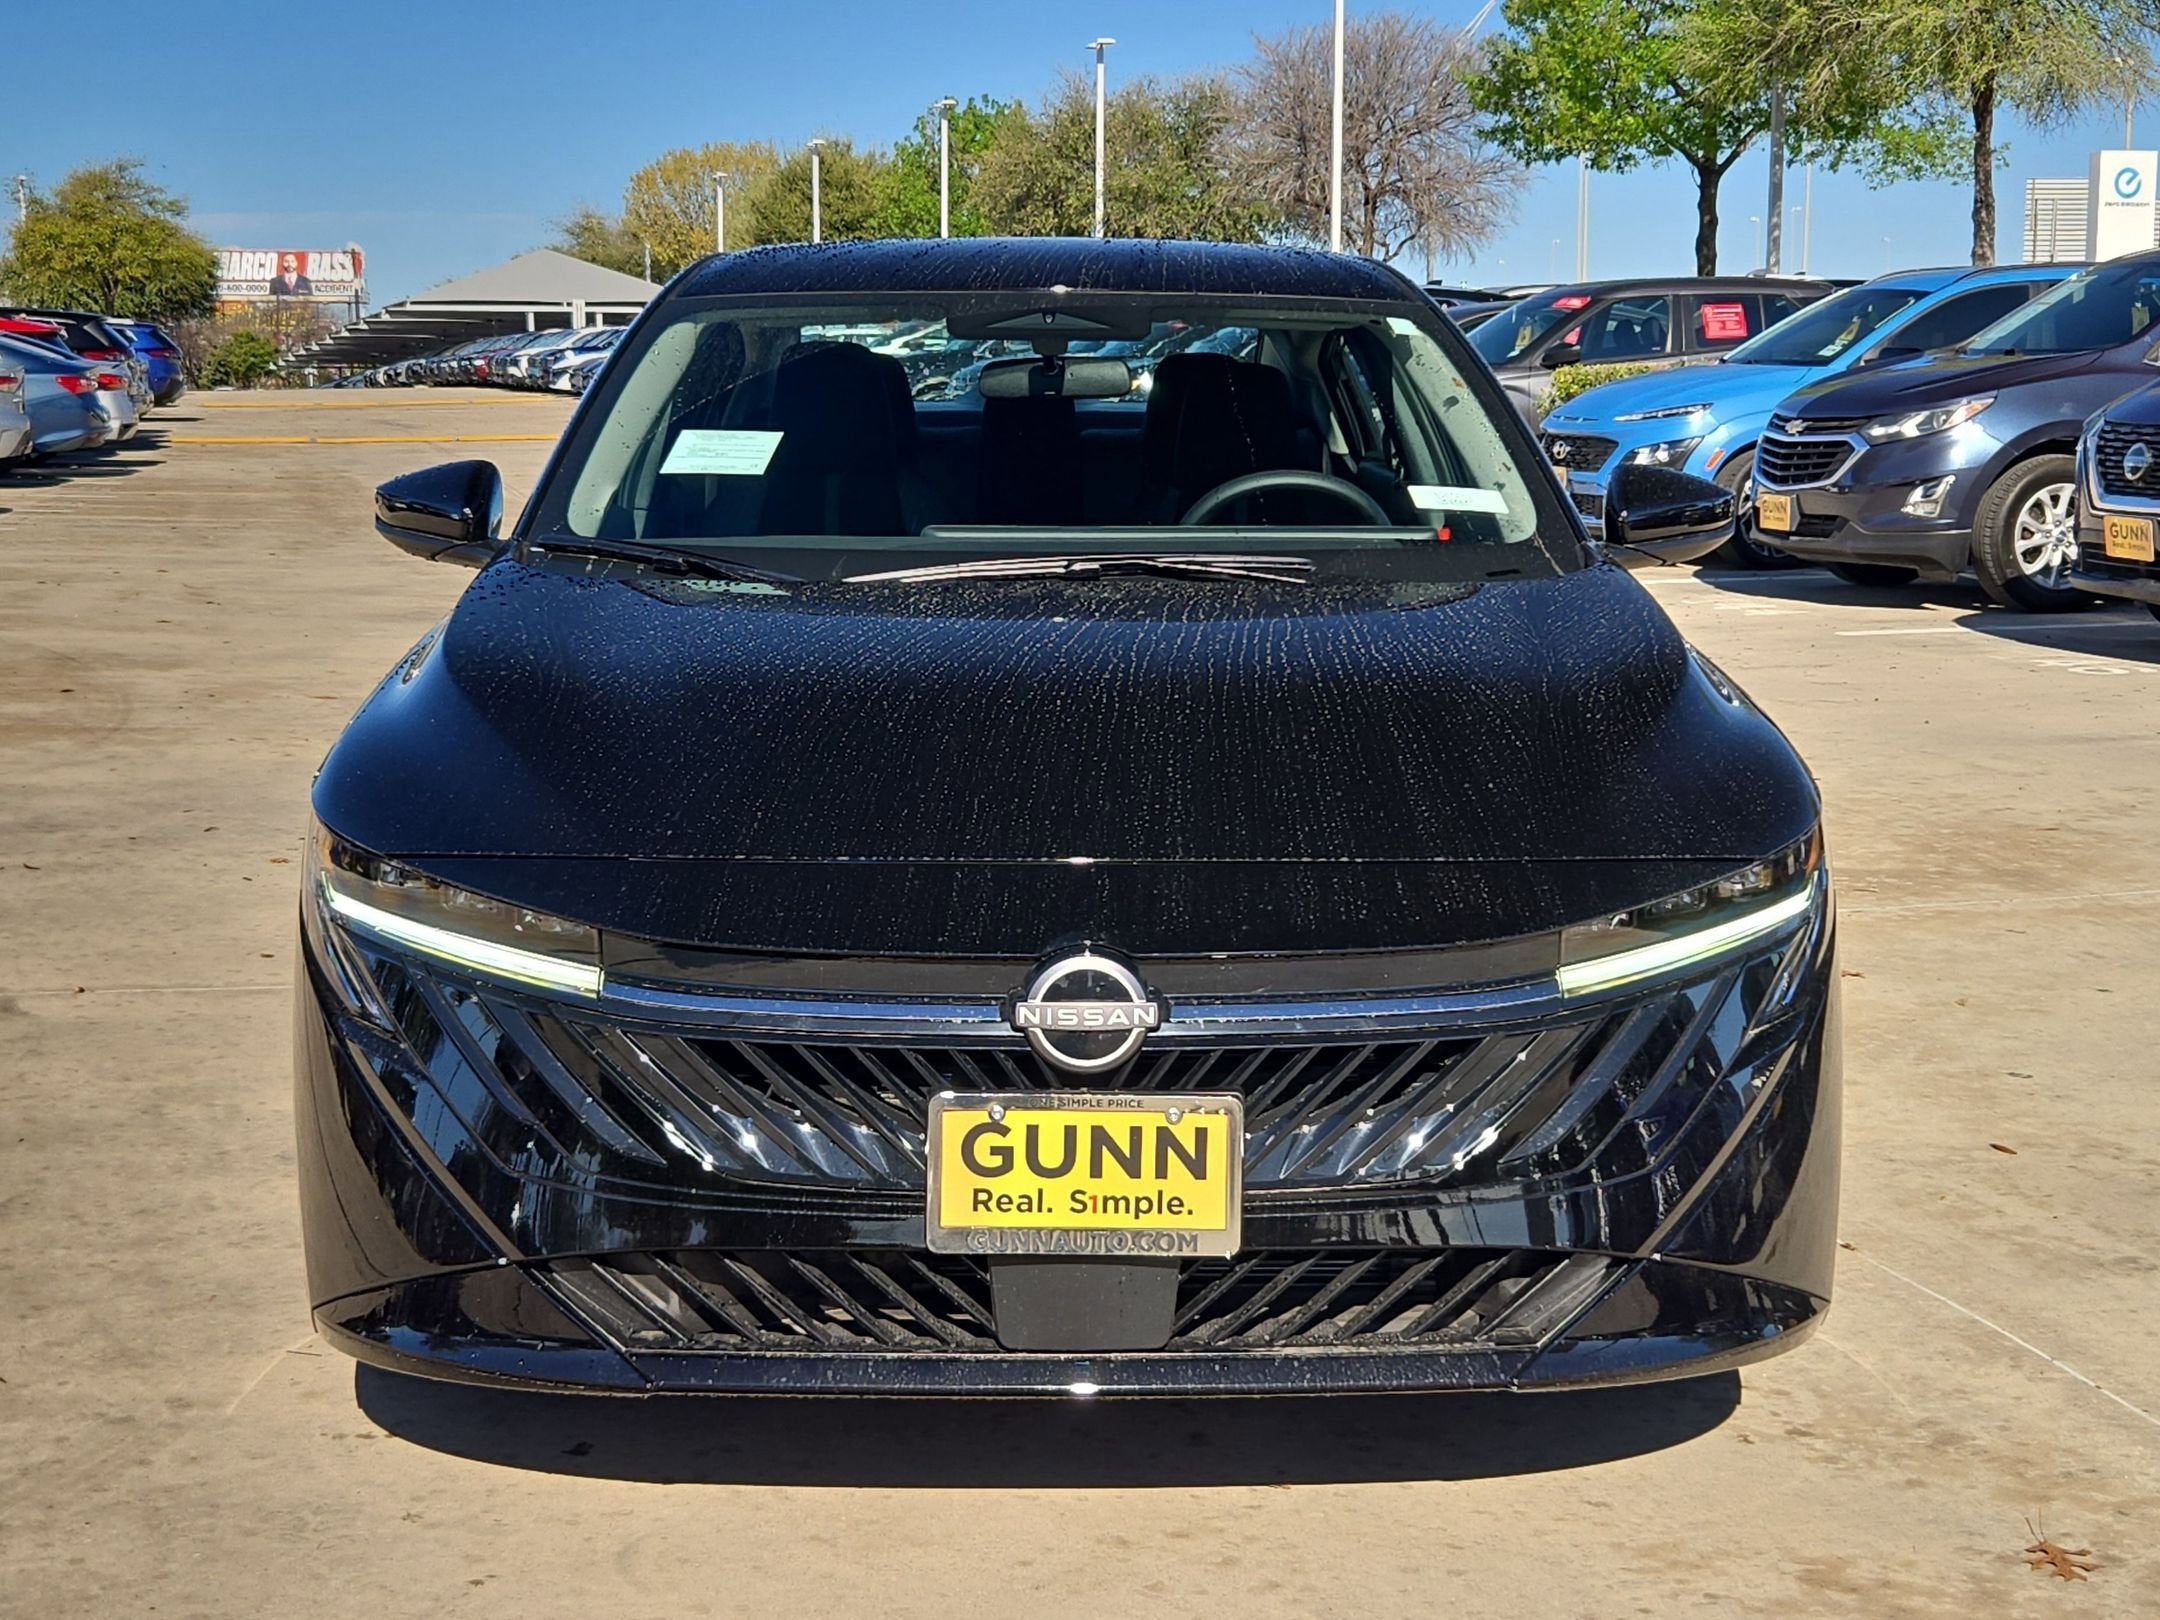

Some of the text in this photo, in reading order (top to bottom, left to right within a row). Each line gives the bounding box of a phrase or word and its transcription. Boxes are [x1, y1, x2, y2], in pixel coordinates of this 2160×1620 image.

[2110, 522, 2148, 542] GUNN
[1019, 1006, 1155, 1026] NISSAN
[1059, 1097, 1104, 1108] SIMPLE
[1108, 1098, 1145, 1109] PRICE
[961, 1122, 1208, 1180] GUNN
[972, 1188, 1053, 1214] Real.
[967, 1228, 1199, 1253] GUNNAUTO.COM
